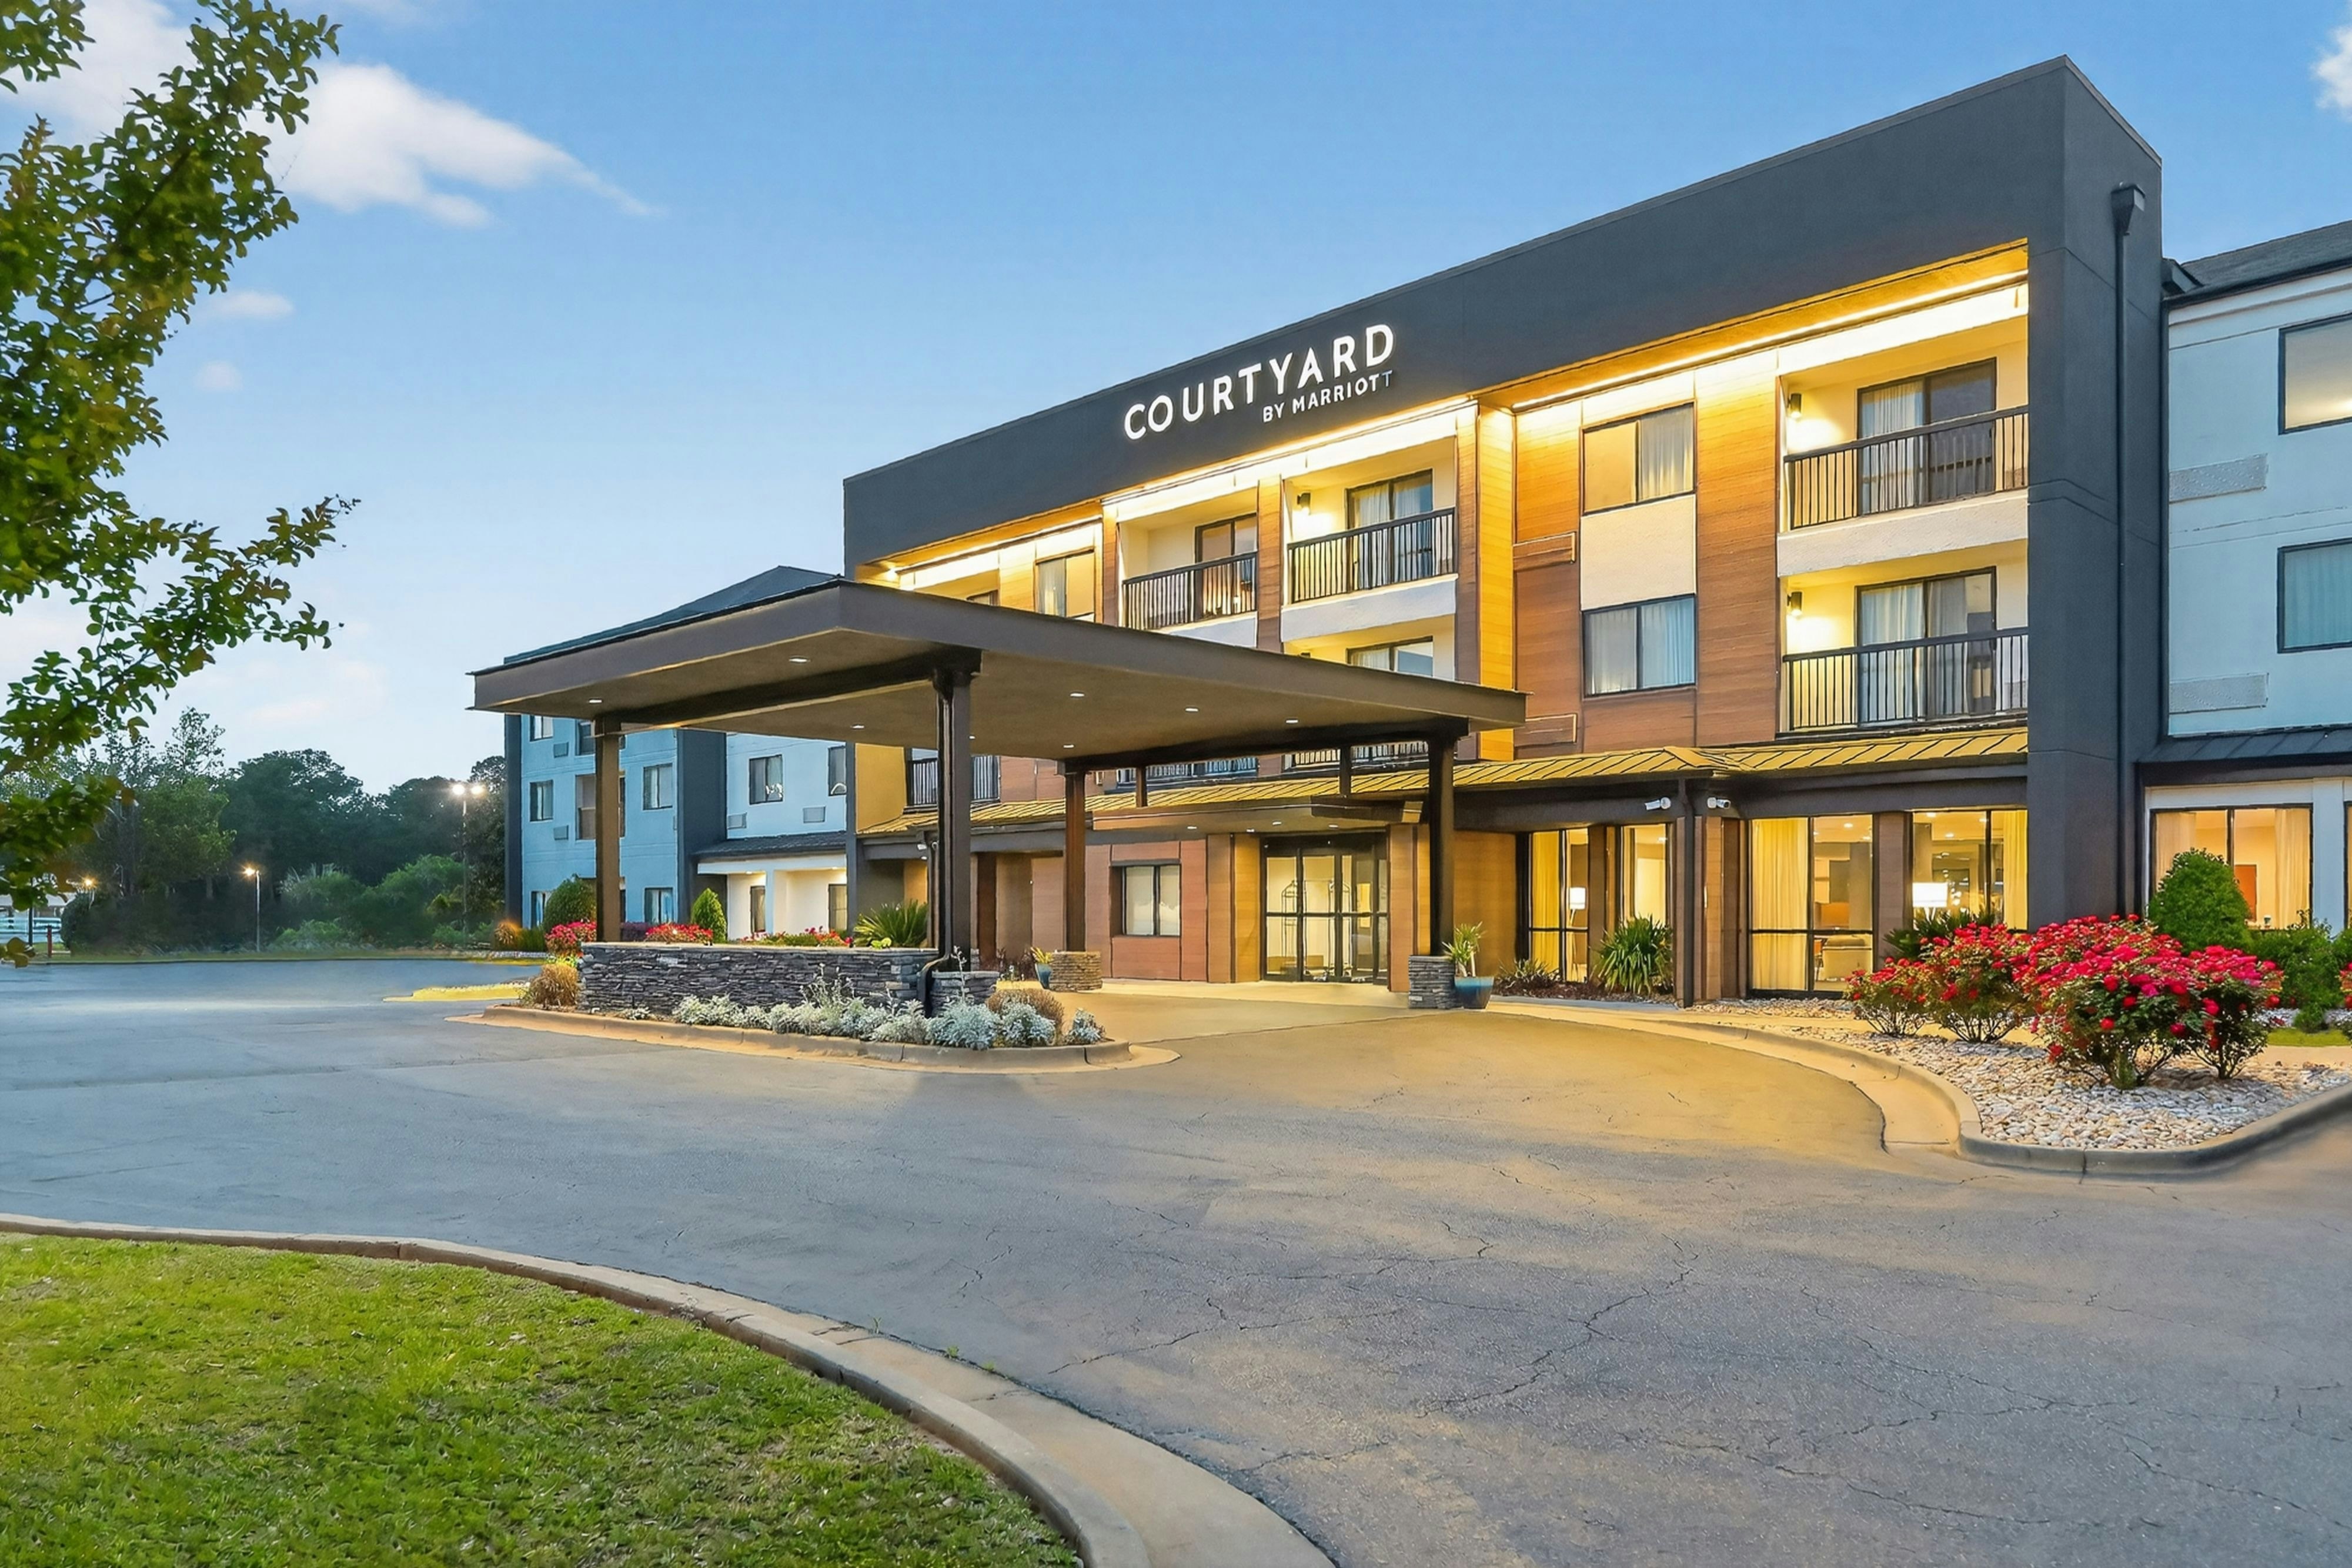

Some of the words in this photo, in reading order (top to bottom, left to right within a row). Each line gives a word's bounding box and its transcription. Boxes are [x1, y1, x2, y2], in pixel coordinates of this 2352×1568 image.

[1124, 324, 1394, 440] COURTYARD
[1262, 402, 1285, 423] BY
[1292, 369, 1393, 414] MARRIOTT
